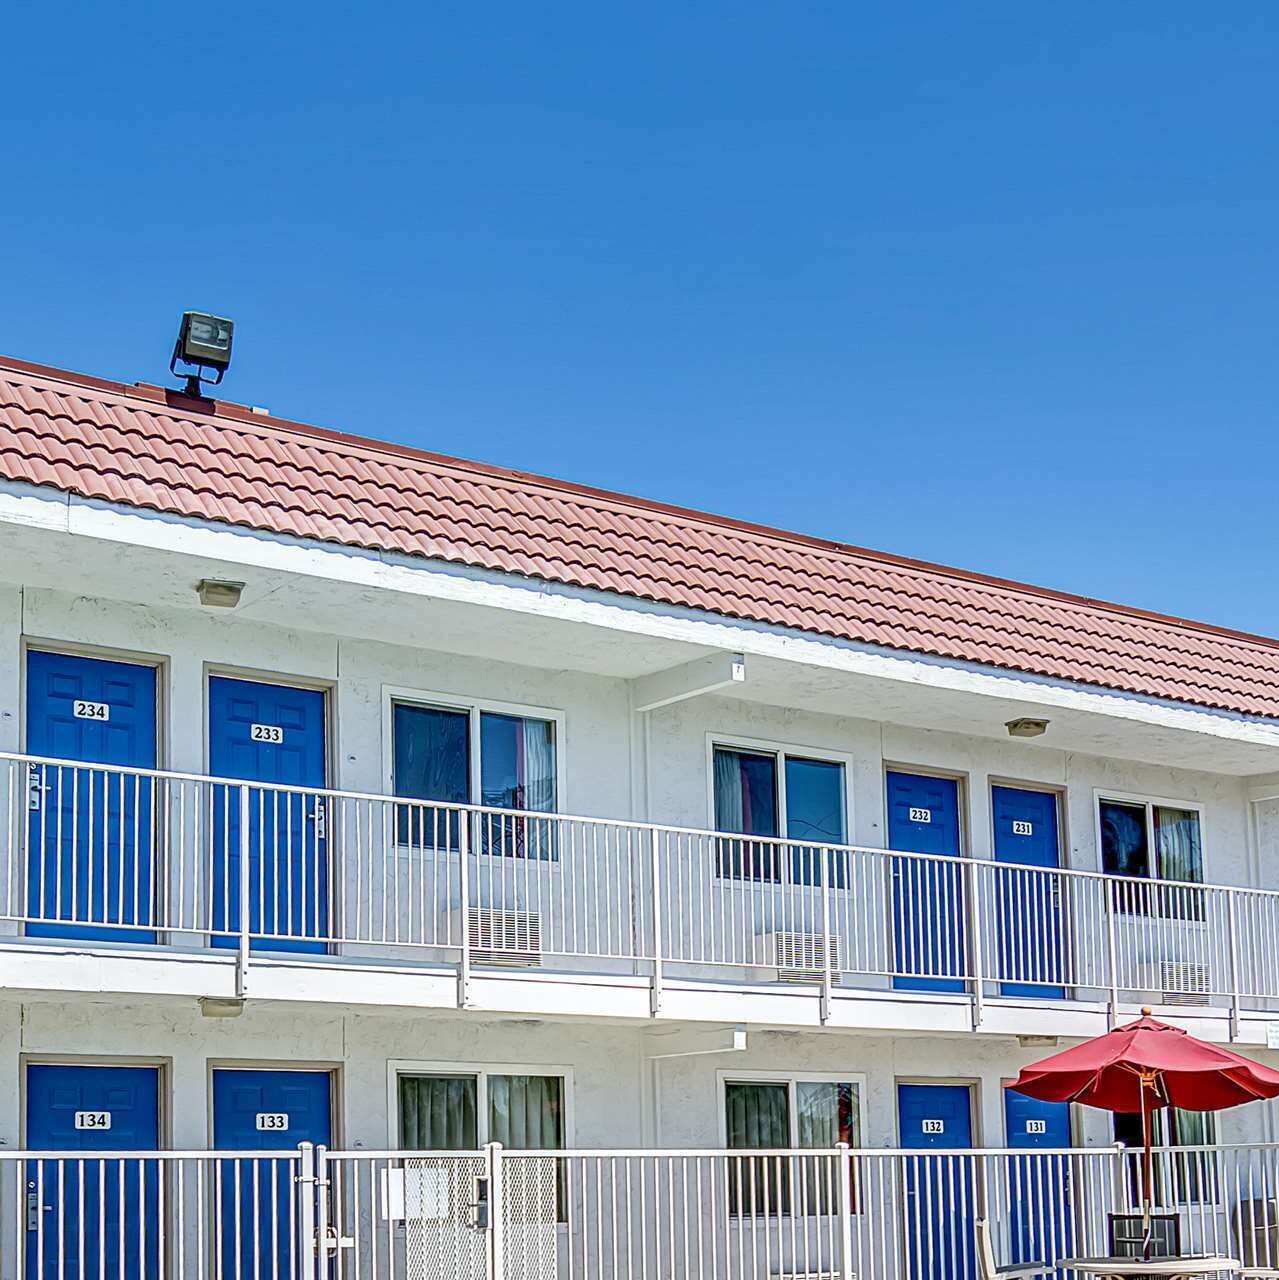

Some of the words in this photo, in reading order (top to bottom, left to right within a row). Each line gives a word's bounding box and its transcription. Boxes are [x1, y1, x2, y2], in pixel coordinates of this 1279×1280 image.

[77, 702, 106, 719] 234
[254, 726, 280, 741] 233
[911, 809, 929, 821] 232
[1015, 823, 1031, 834] 231
[79, 1113, 106, 1127] 134
[260, 1115, 285, 1128] 133
[924, 1121, 942, 1132] 132
[1028, 1122, 1044, 1132] 131
